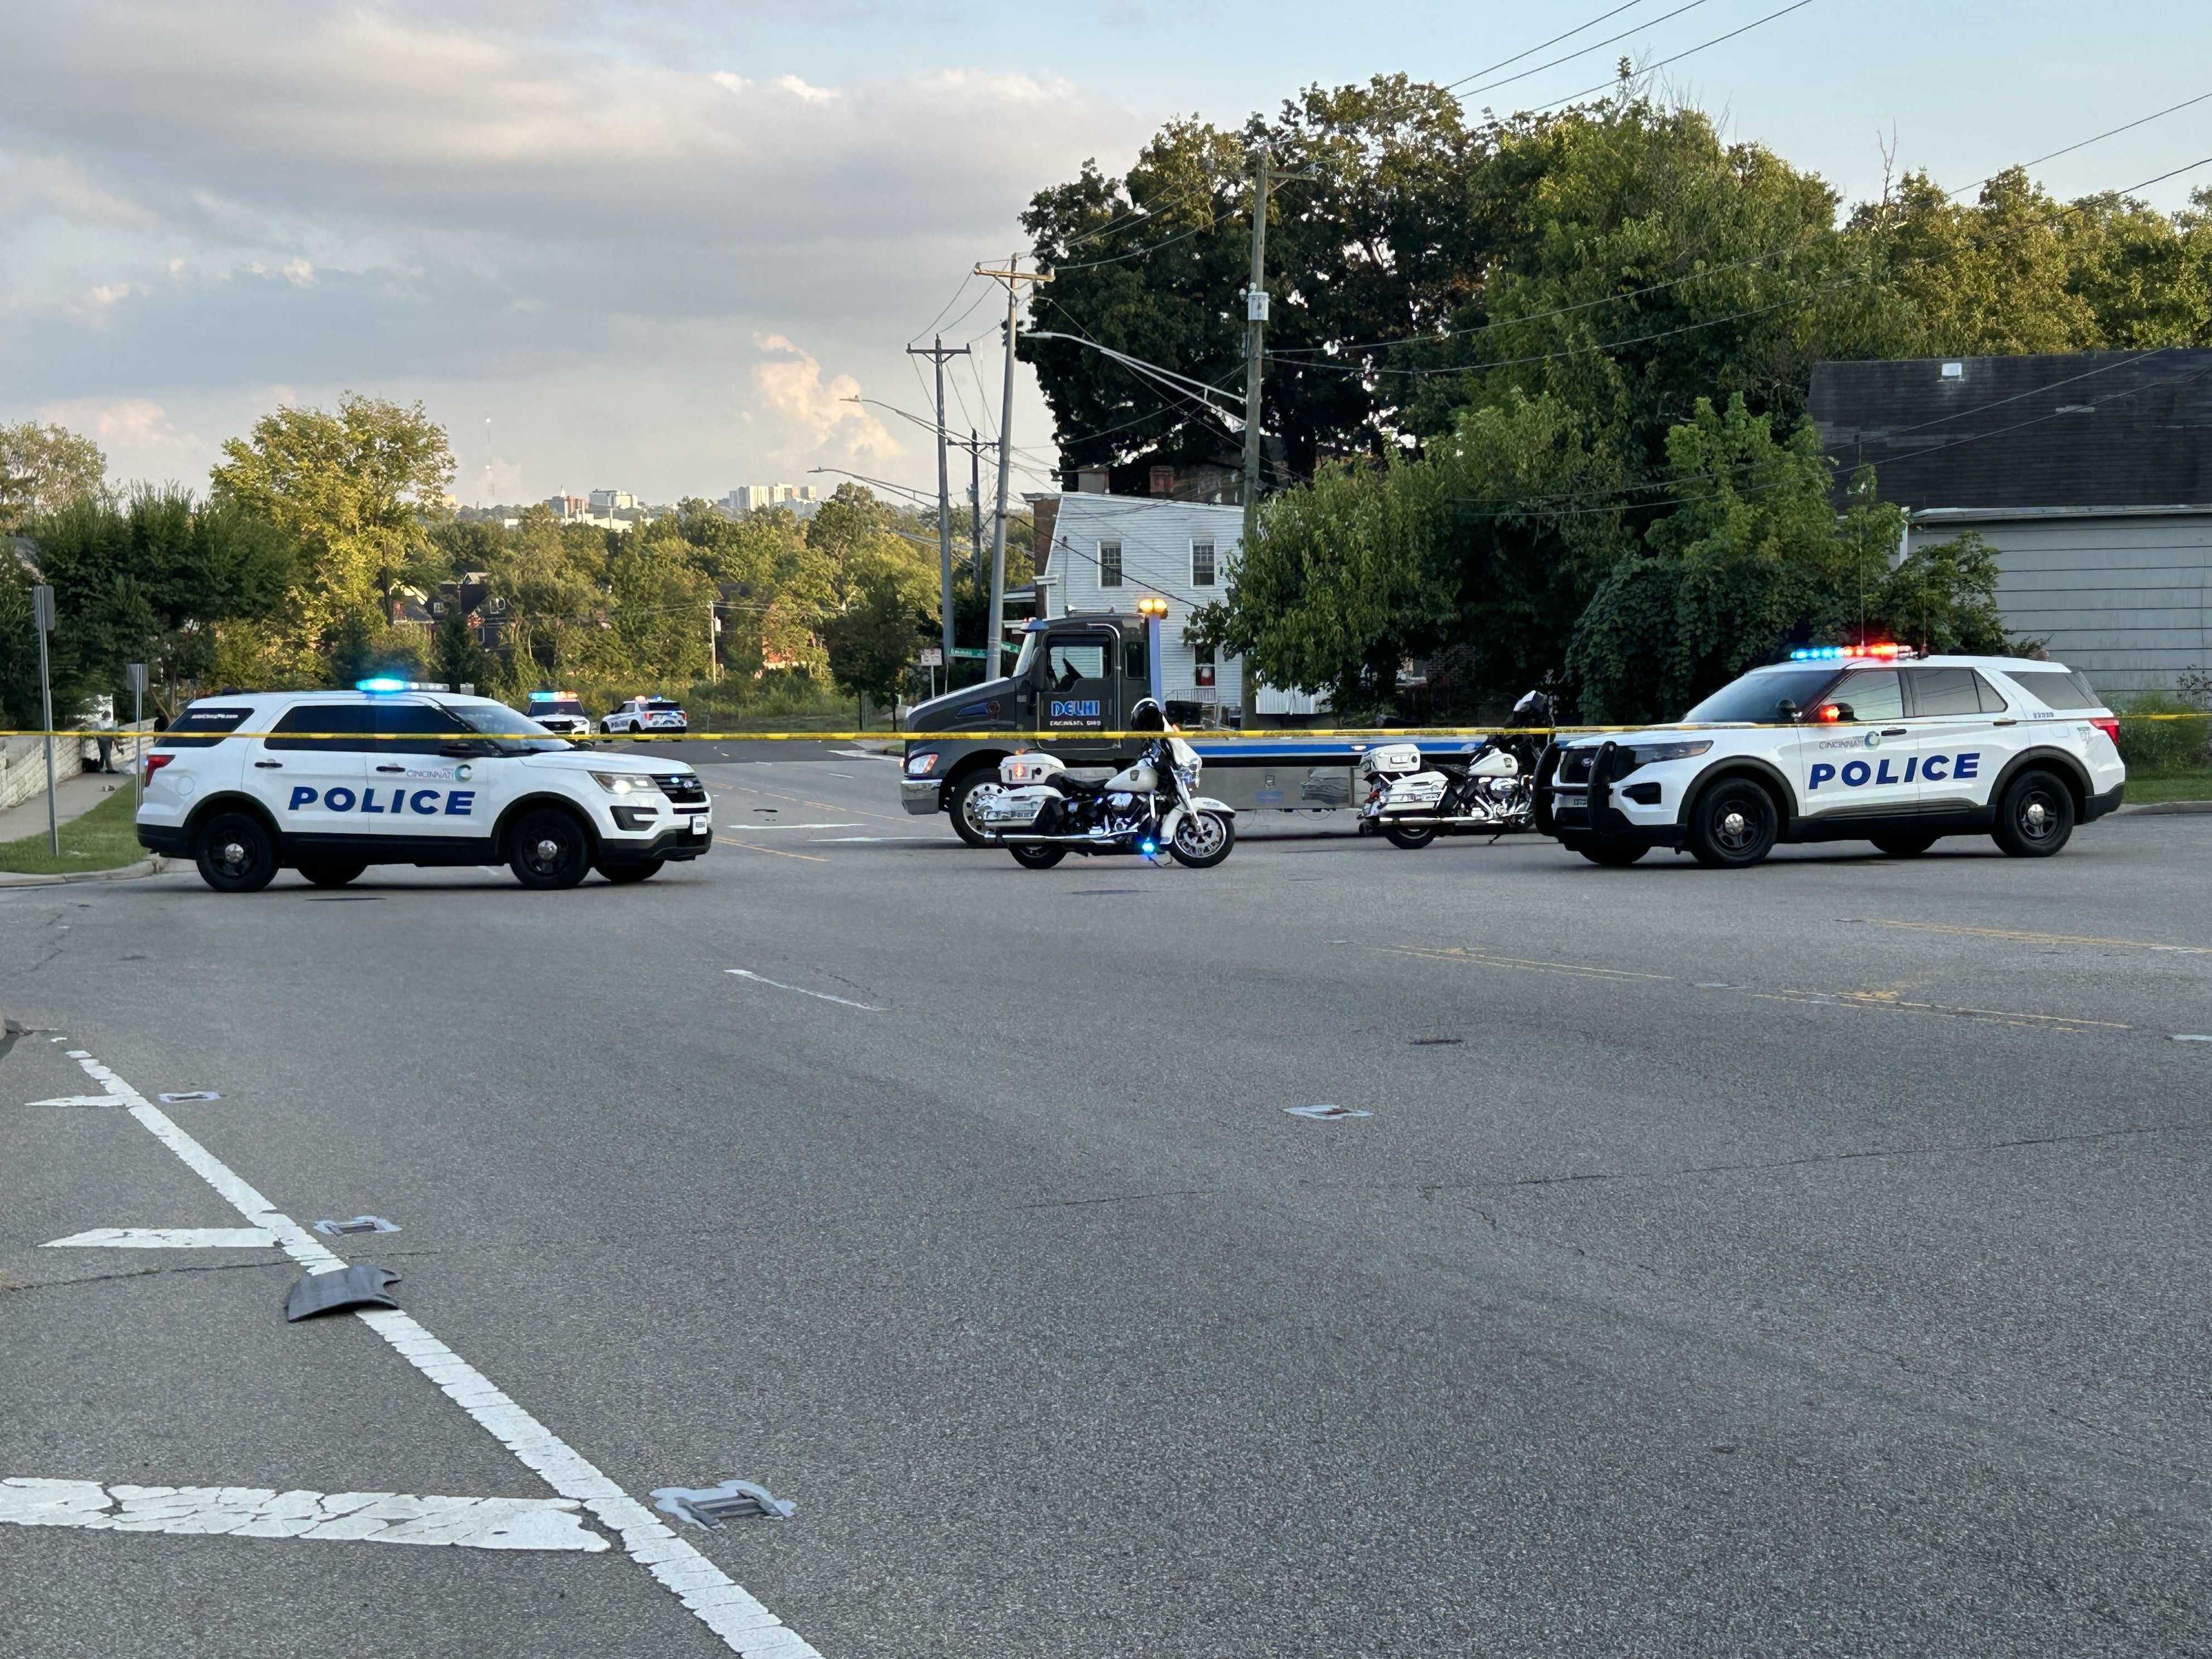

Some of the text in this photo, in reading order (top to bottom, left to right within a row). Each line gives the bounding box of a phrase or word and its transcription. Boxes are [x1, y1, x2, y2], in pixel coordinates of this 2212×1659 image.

[1051, 701, 1100, 716] DELHI
[1809, 753, 1980, 789] POLICE
[288, 787, 475, 815] POLICE
